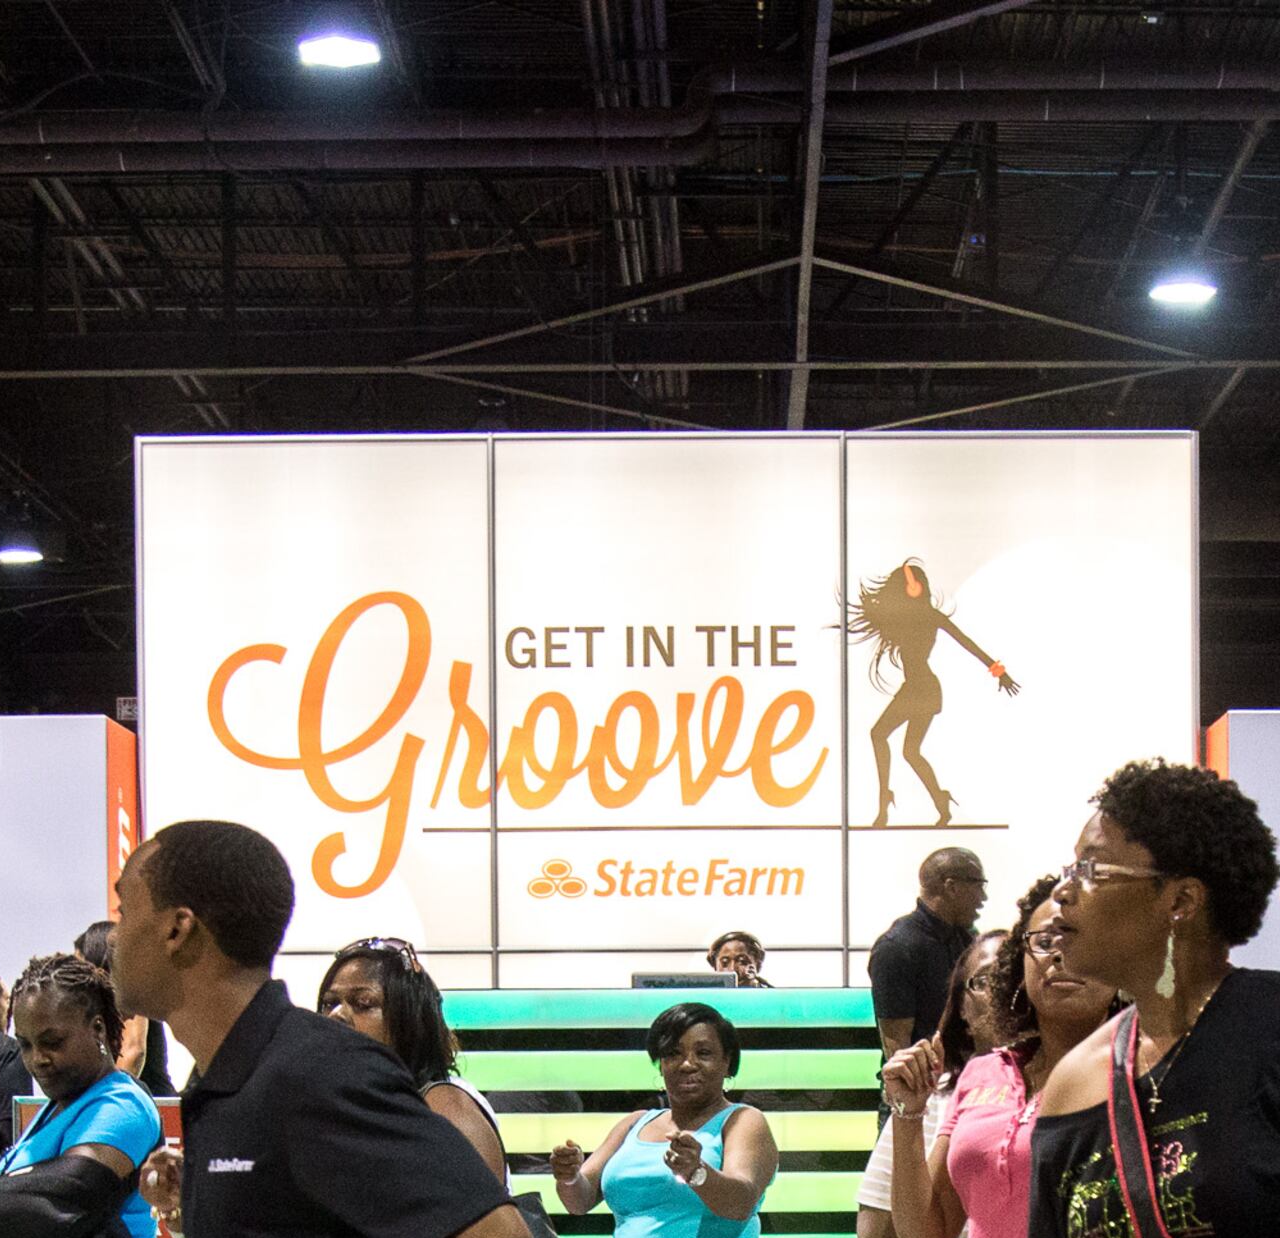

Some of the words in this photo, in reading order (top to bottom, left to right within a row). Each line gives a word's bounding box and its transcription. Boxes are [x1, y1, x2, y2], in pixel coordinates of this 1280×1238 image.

[504, 626, 606, 669] GET
[625, 625, 676, 667] IN
[695, 625, 798, 667] THE
[206, 590, 830, 899] Groove
